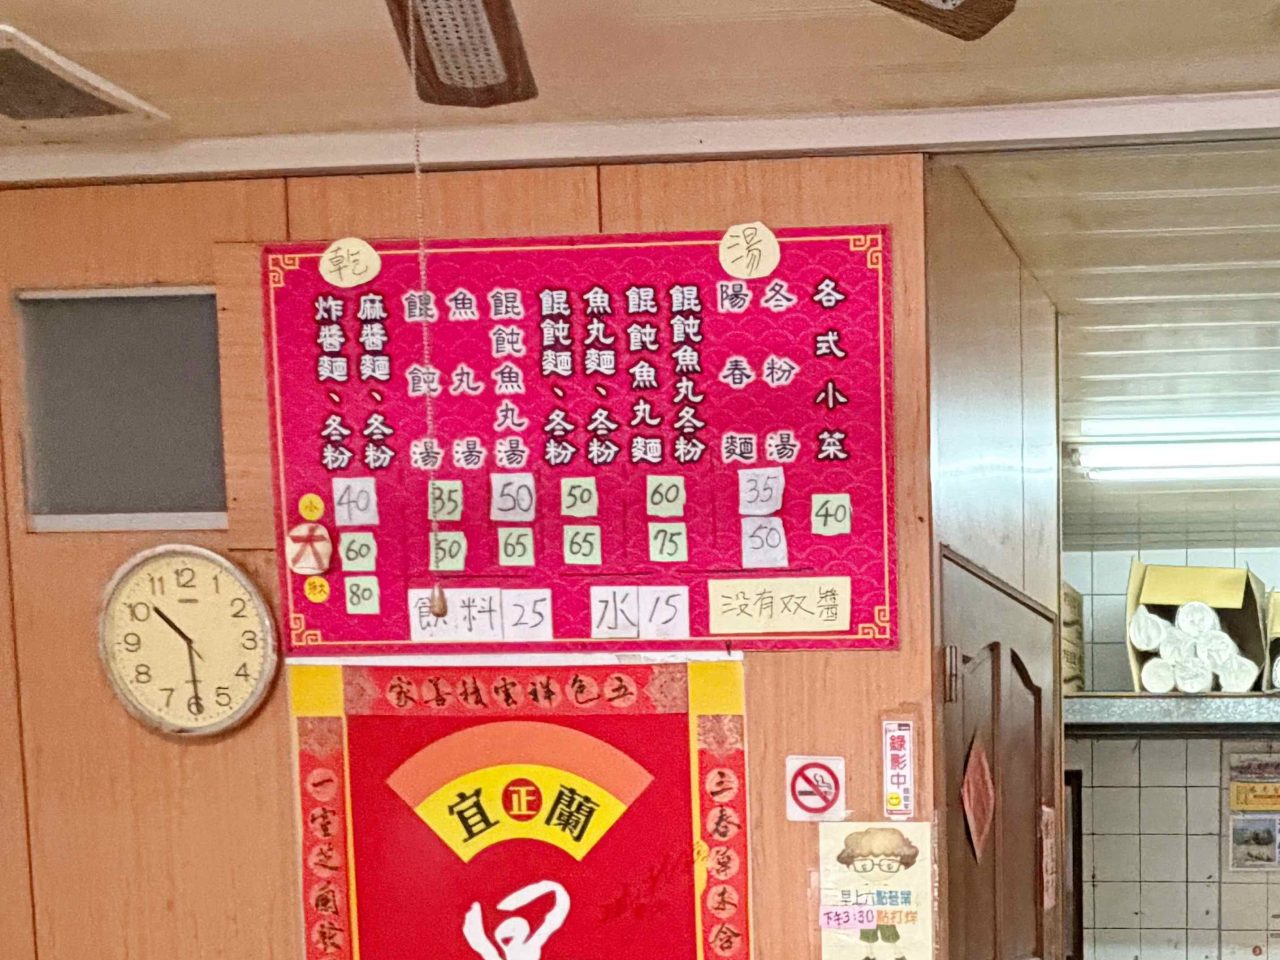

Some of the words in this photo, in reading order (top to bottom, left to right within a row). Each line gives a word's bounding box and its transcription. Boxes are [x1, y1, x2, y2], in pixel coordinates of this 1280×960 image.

[328, 247, 368, 279] 乾
[727, 228, 764, 277] 湯
[812, 278, 849, 462] 各式小菜
[433, 487, 459, 506] 35
[497, 482, 533, 512] 50
[567, 486, 592, 507] 50
[650, 484, 679, 504] 60
[746, 477, 774, 503] 35
[337, 485, 370, 520] 40
[815, 501, 847, 527] 40
[289, 526, 328, 570] 大
[435, 538, 461, 558] 50
[503, 533, 528, 557] 65
[569, 532, 594, 556] 65
[654, 532, 682, 555] 75
[748, 526, 781, 550] 50
[346, 540, 370, 561] 60
[151, 577, 164, 595] 11
[175, 568, 195, 587] 12
[349, 583, 373, 606] 80
[129, 602, 149, 621] 10
[231, 598, 246, 617] 2
[512, 597, 546, 628] 25
[597, 592, 636, 631] 水
[648, 593, 680, 625] 15
[124, 633, 140, 652] 9
[242, 631, 257, 650] 3
[136, 664, 150, 683] 8
[235, 663, 249, 681] 4
[160, 688, 174, 707] 7
[216, 687, 231, 706] 5
